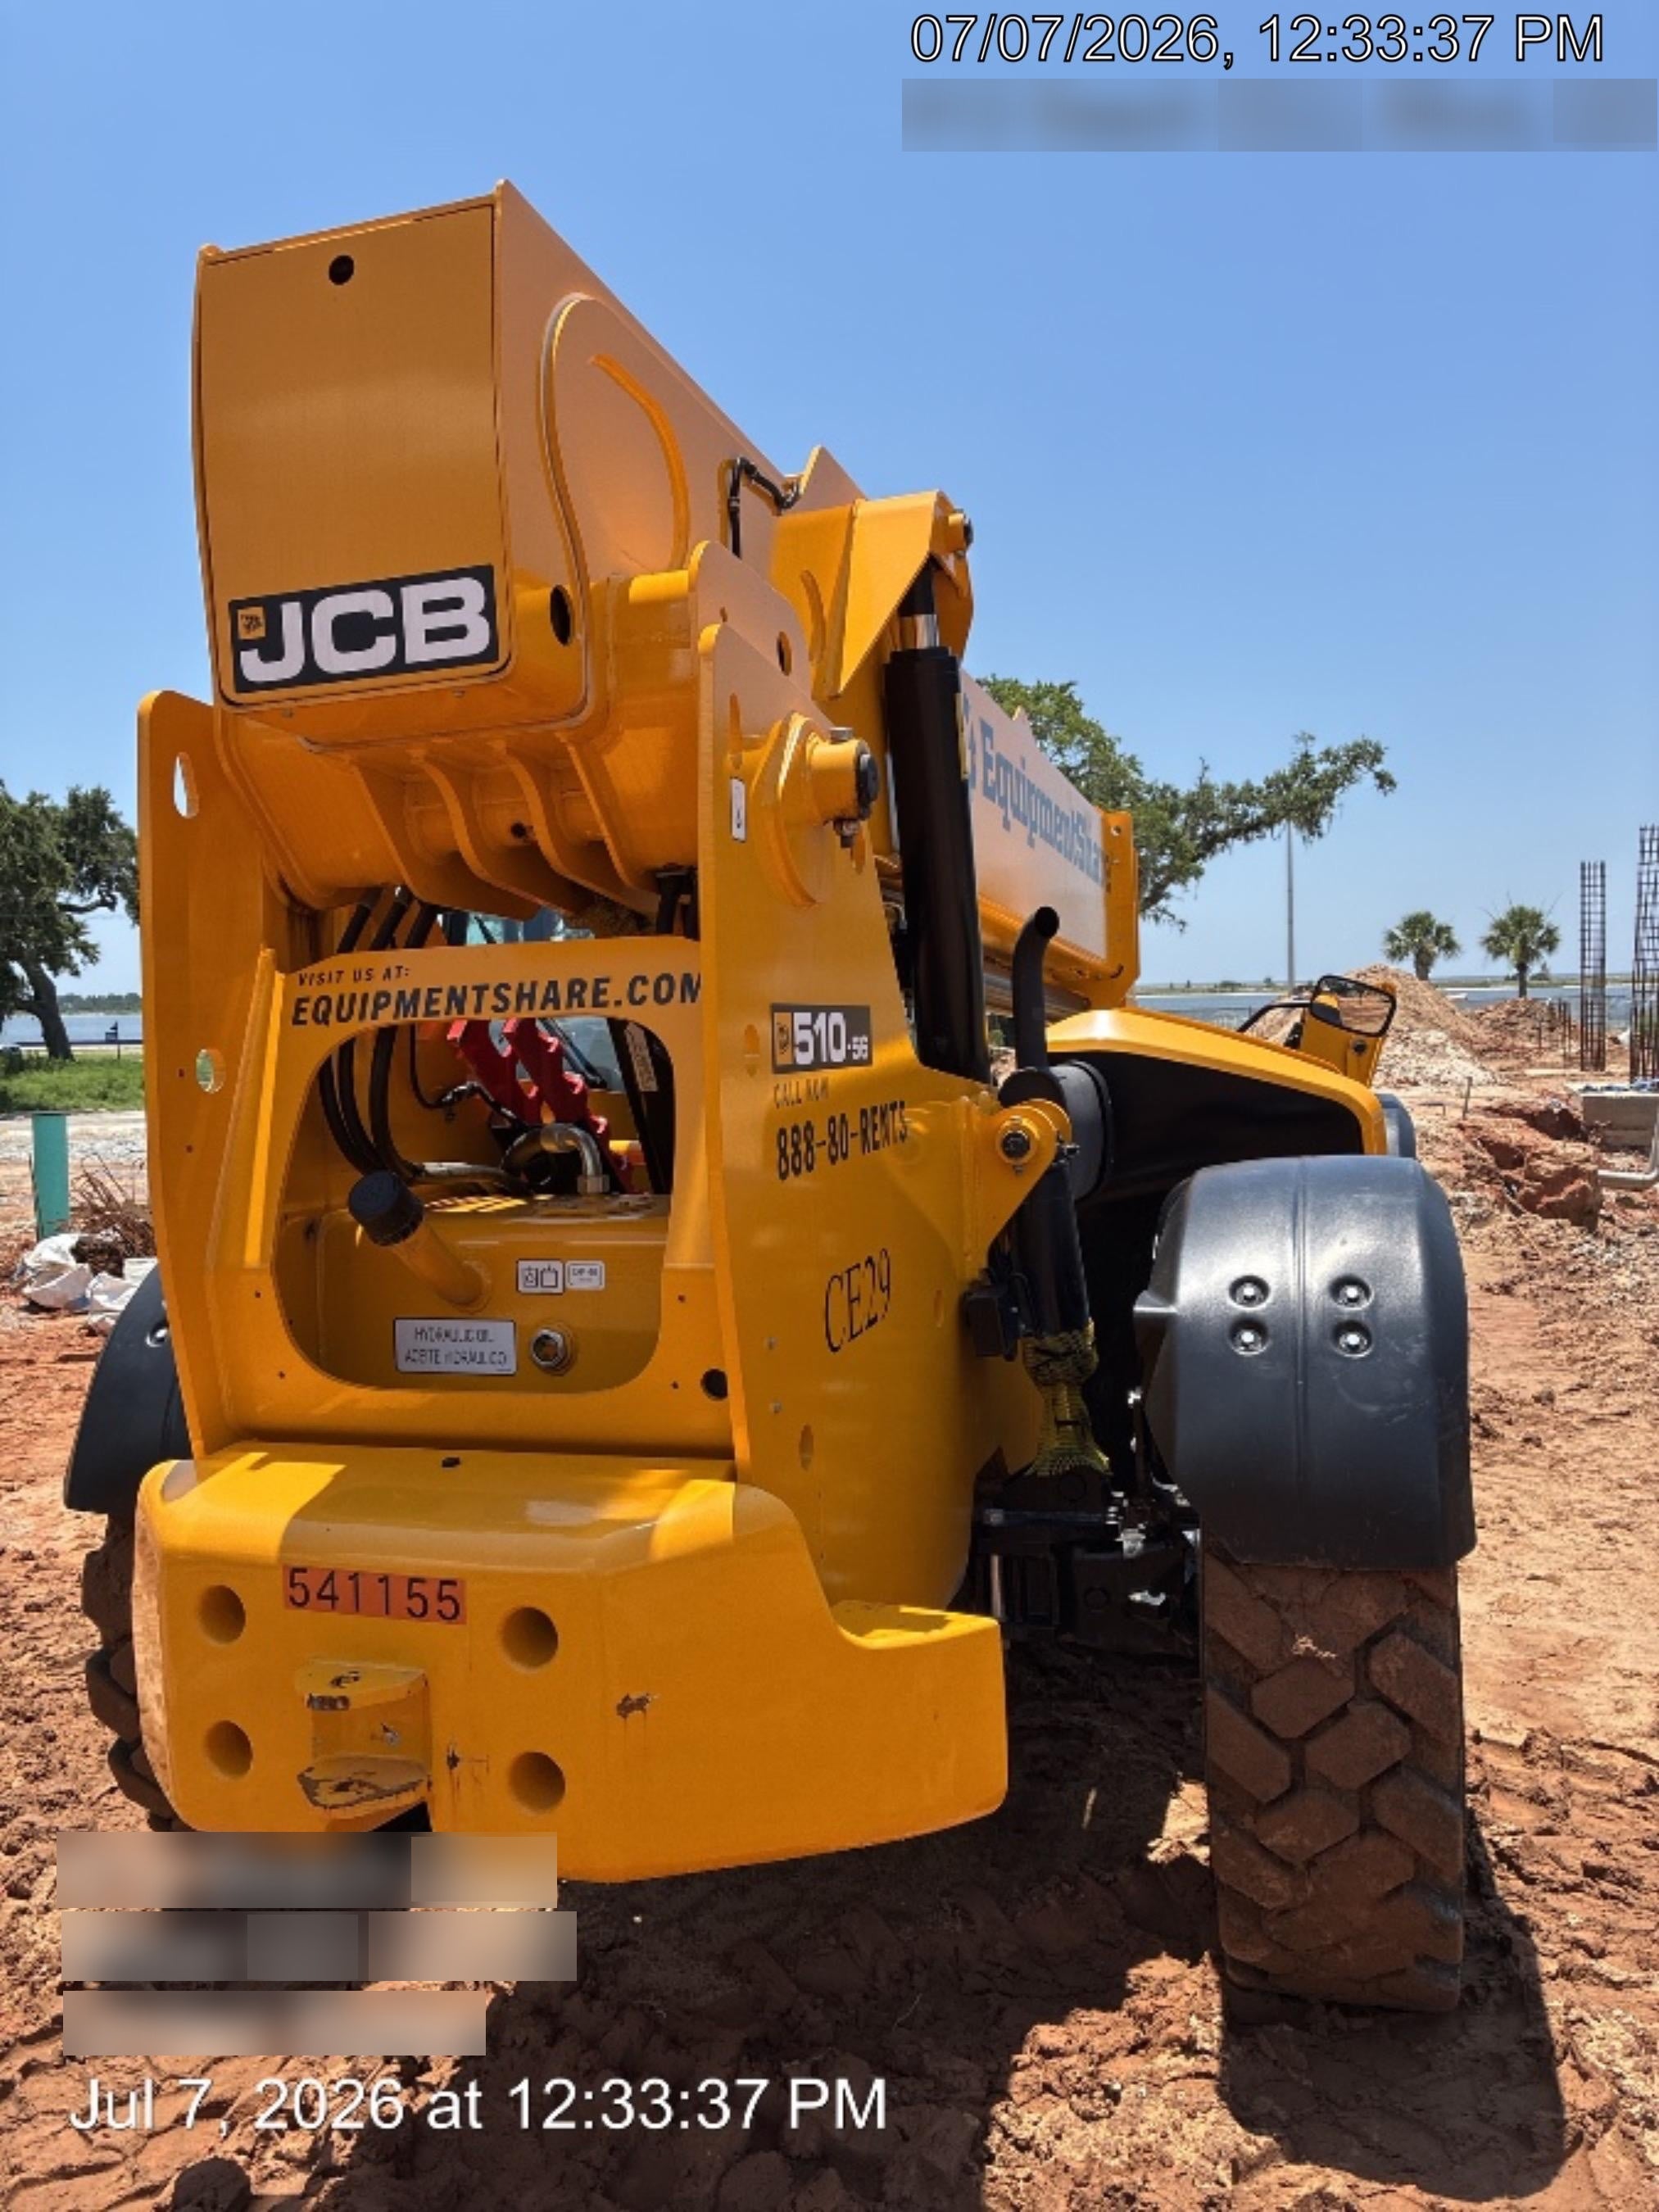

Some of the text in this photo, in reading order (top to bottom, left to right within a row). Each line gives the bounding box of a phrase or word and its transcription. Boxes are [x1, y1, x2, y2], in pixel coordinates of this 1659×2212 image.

[239, 576, 491, 682] JCB
[298, 964, 410, 986] VISIT US AT:
[288, 1566, 460, 1620] 541155
